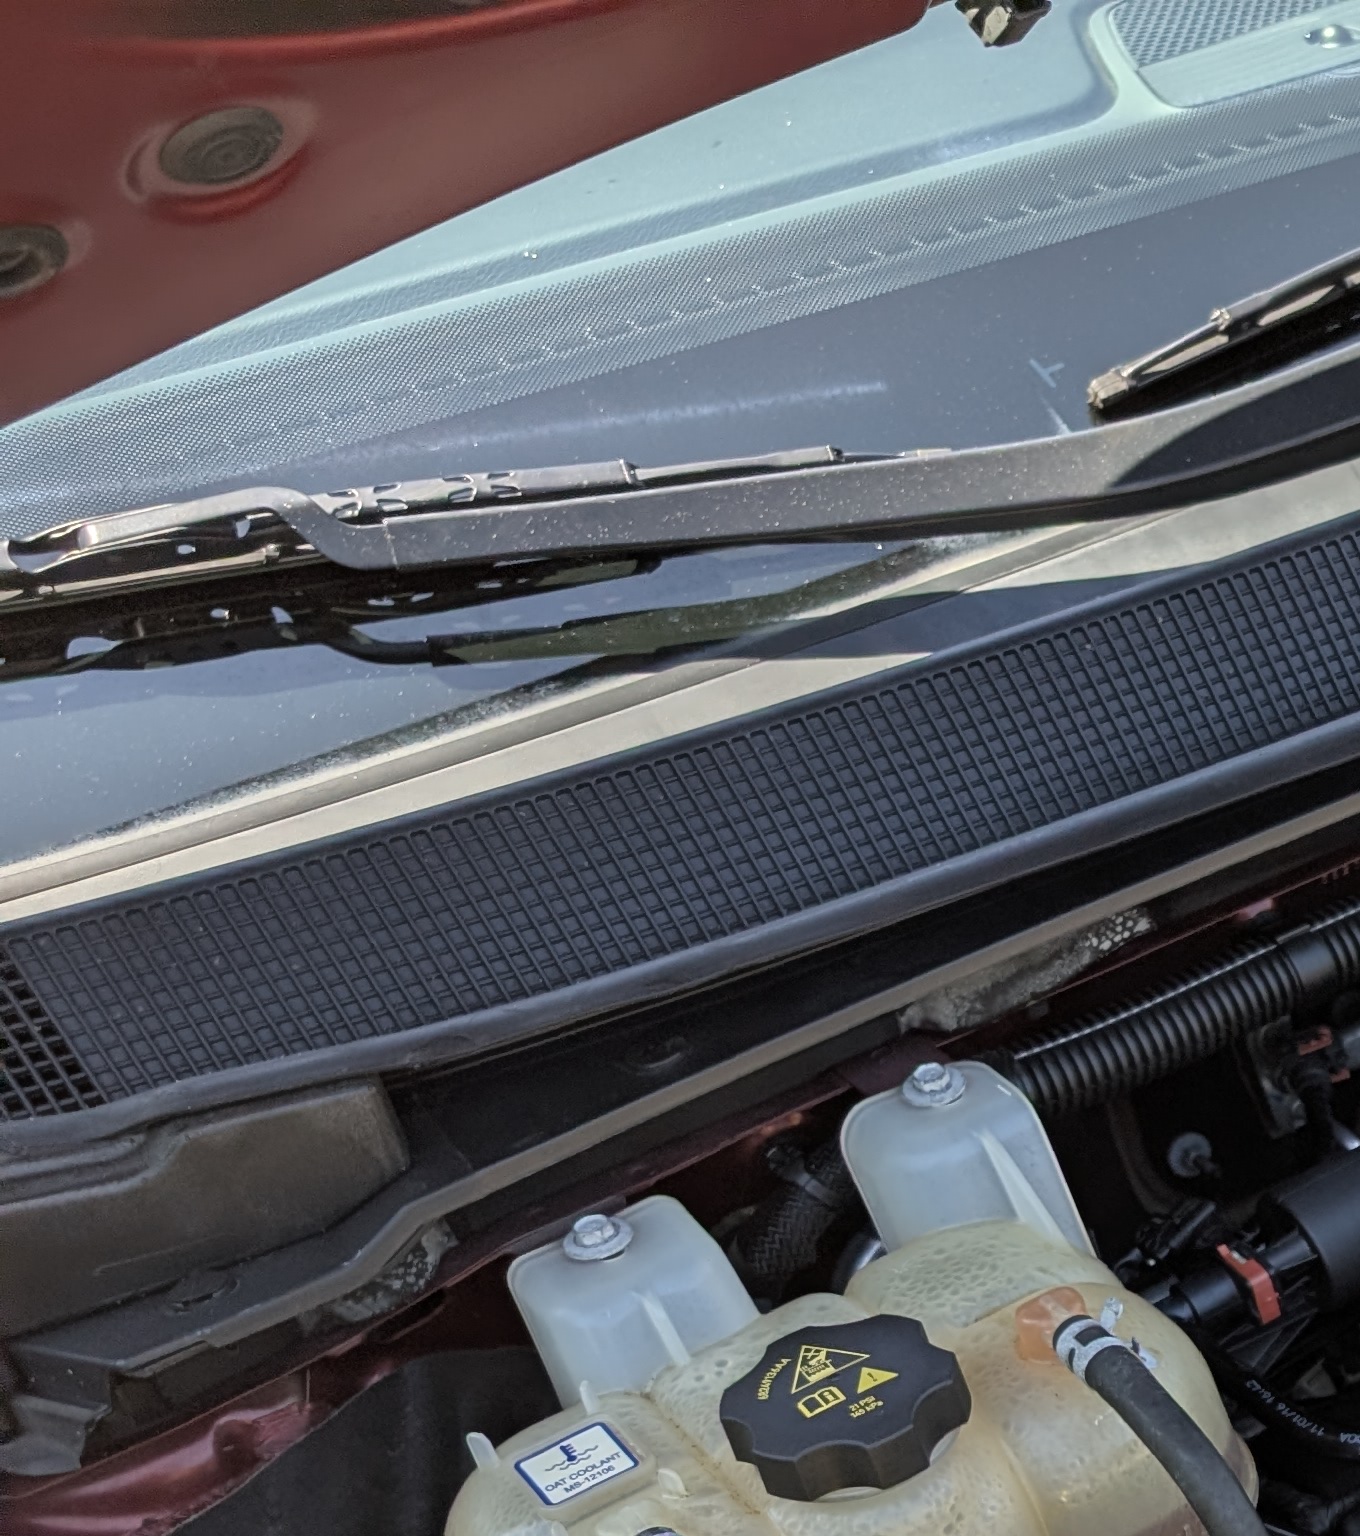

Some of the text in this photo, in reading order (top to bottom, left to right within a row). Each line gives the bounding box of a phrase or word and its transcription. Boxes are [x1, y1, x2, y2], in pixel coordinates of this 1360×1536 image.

[545, 1451, 622, 1493] OAT COOLANT
[563, 1465, 616, 1494] MS-12106
